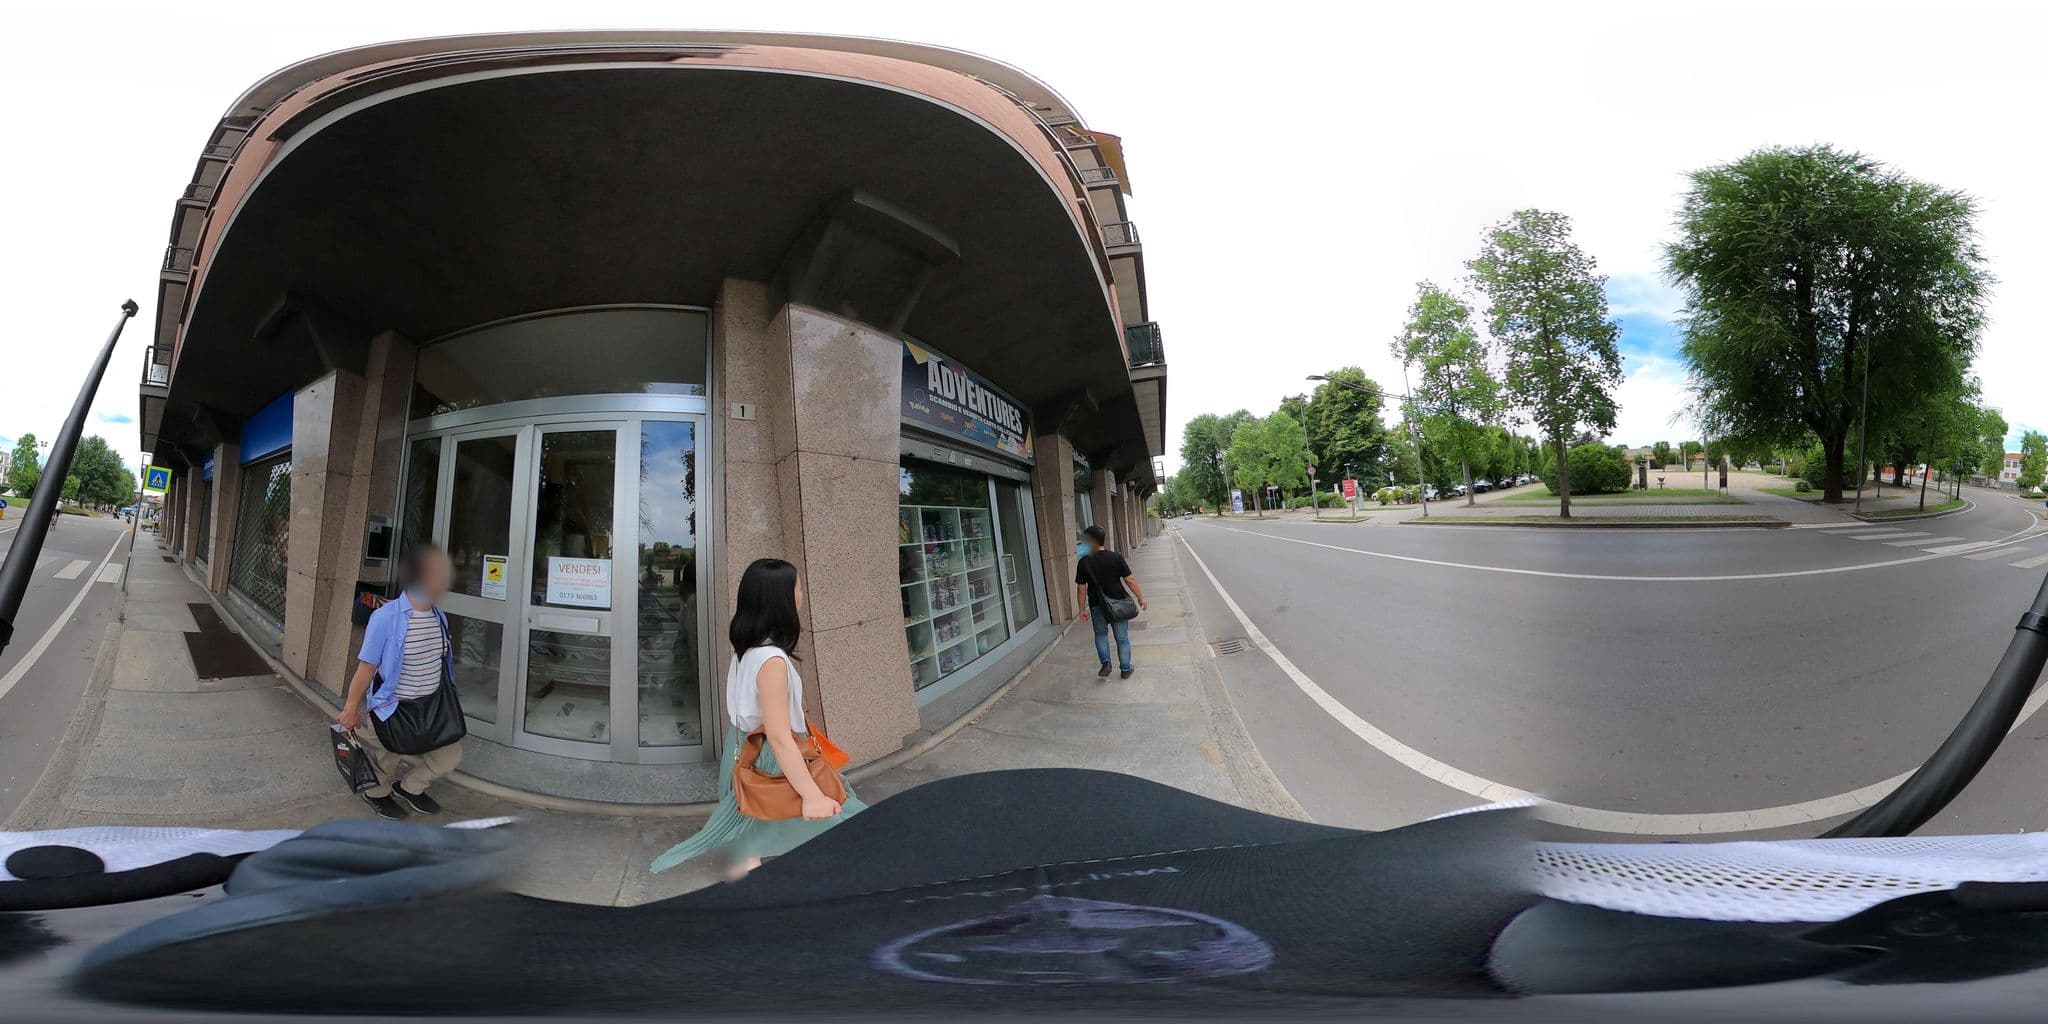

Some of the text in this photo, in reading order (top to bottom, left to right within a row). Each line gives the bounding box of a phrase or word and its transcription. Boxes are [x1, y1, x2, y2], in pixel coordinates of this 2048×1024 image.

[928, 360, 1023, 434] ADVENTURES
[929, 394, 958, 411] SCAMBIO
[740, 405, 744, 418] 1
[558, 563, 601, 575] VENDESI
